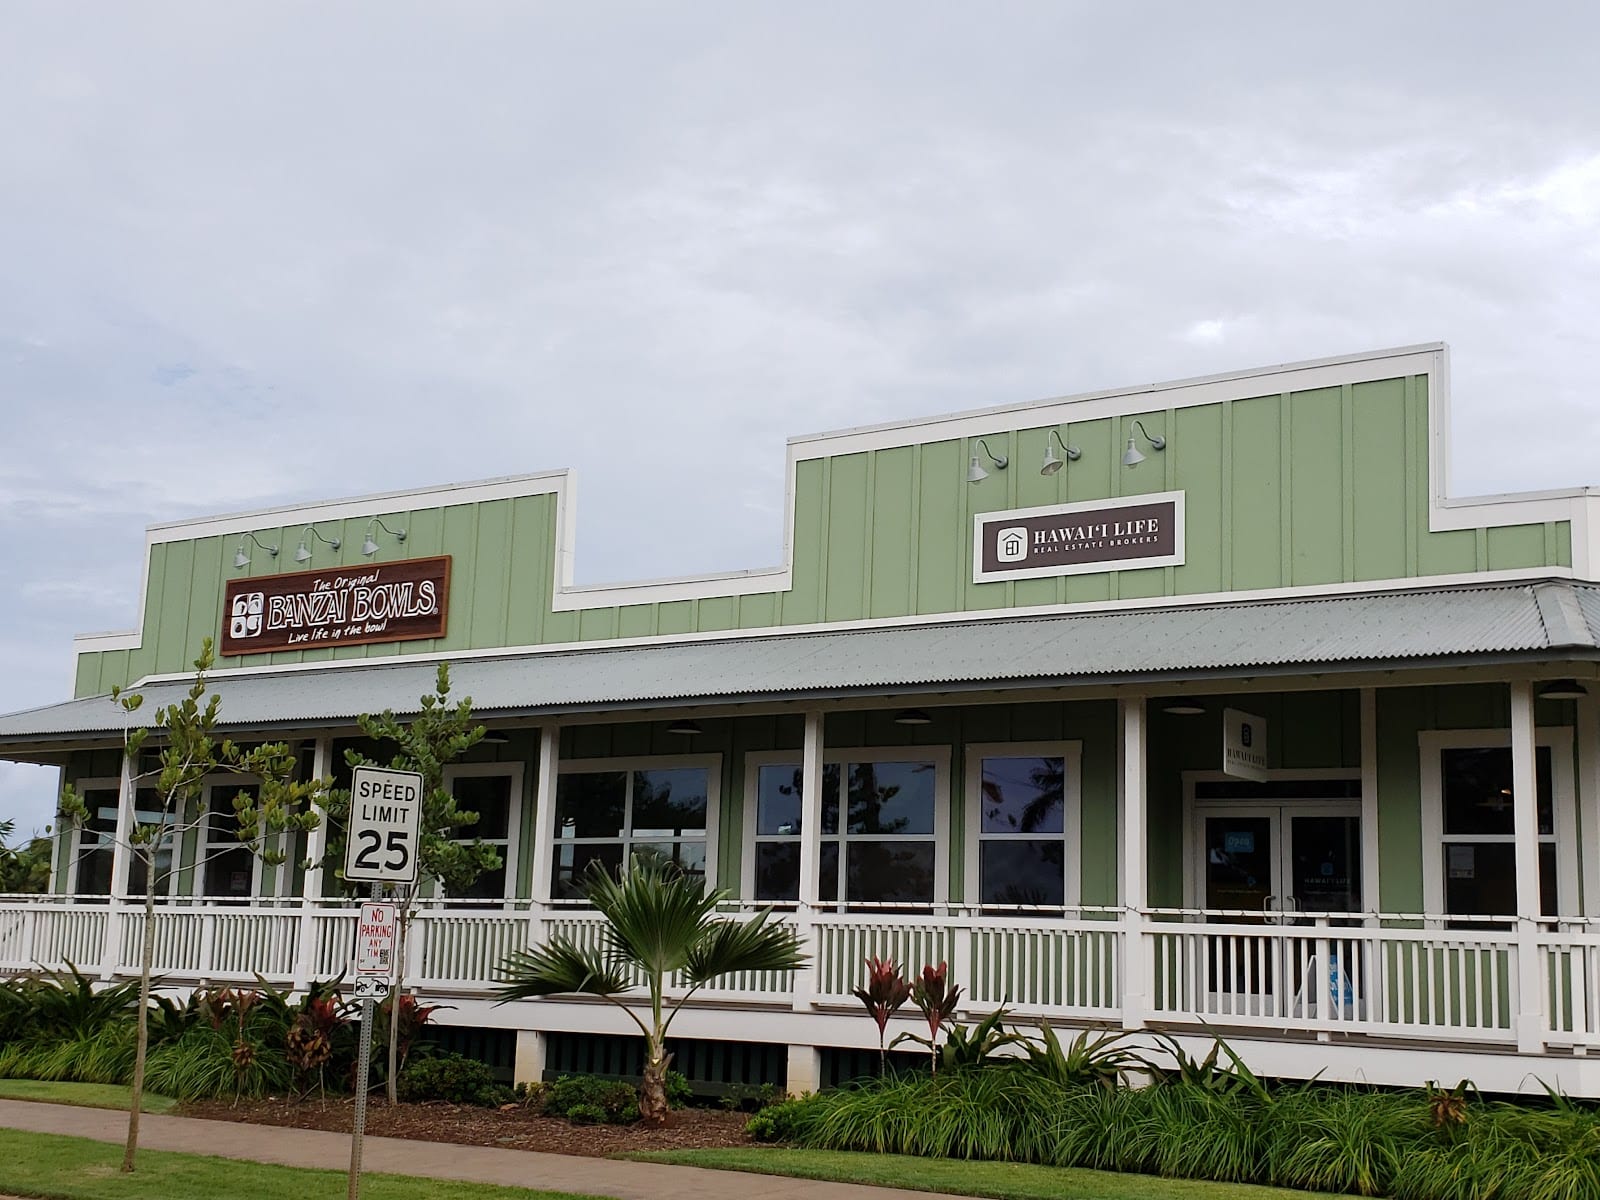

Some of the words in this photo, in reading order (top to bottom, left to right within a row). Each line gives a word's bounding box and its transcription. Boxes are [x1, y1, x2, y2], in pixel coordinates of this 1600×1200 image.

[1113, 518, 1159, 536] LIFE
[1034, 544, 1059, 554] REAL
[1065, 540, 1103, 551] ESTATE
[1110, 535, 1158, 547] BROKERS
[313, 578, 331, 592] The
[334, 569, 380, 592] Original
[267, 589, 348, 629] BANZAI
[351, 580, 436, 621] BOWLS
[288, 632, 309, 643] Live
[311, 628, 328, 641] life
[331, 631, 341, 639] in
[343, 624, 362, 636] the
[364, 618, 387, 632] bowl
[359, 781, 416, 802] SPEED
[362, 804, 409, 824] LIMIT
[354, 829, 409, 871] 25
[371, 909, 384, 923] NO
[362, 925, 392, 938] PARKING
[369, 938, 383, 948] ANY
